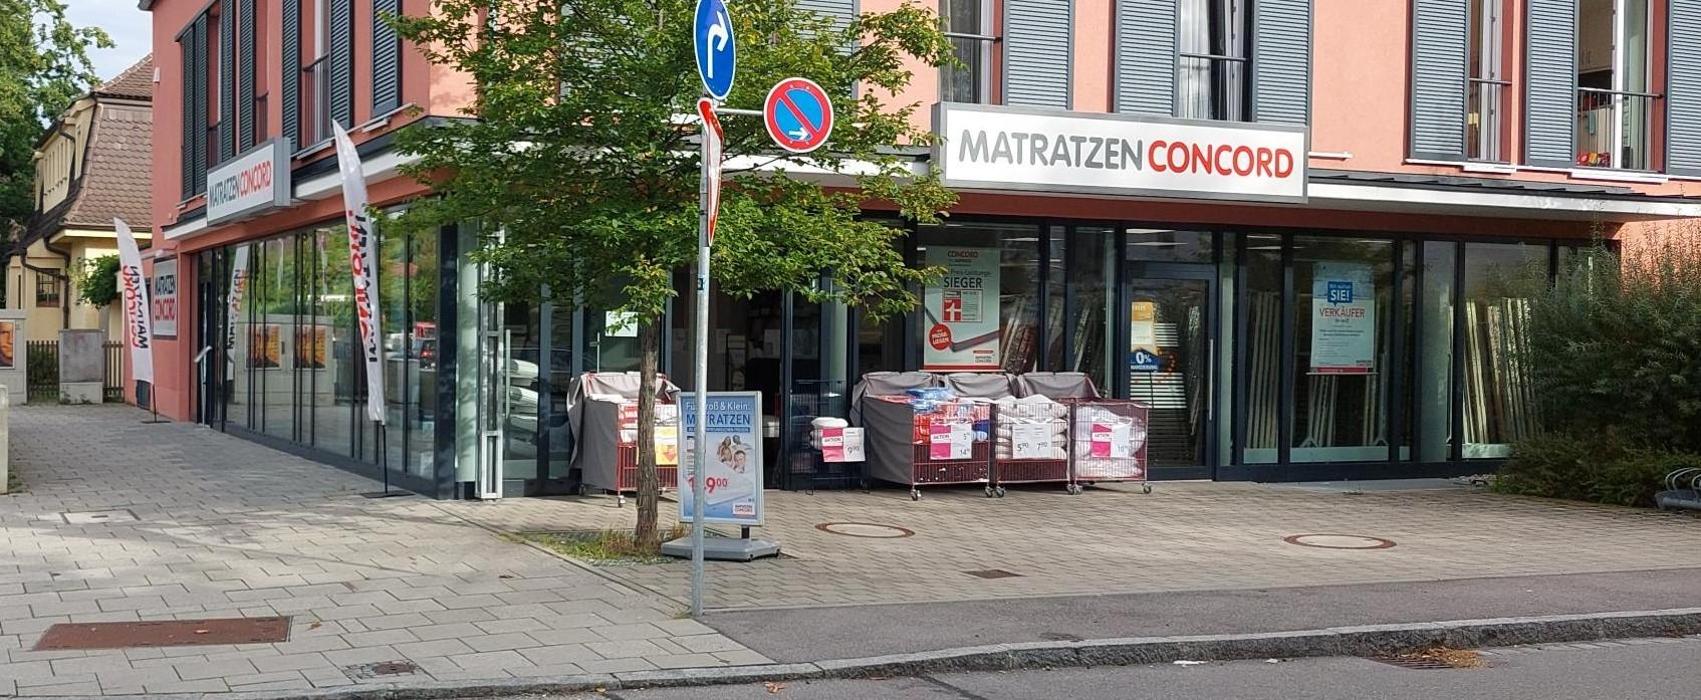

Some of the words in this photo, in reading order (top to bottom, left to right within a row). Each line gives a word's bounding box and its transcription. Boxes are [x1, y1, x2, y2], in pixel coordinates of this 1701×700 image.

[959, 129, 1143, 170] MATRATZEN
[1148, 140, 1294, 178] CONCORD
[209, 174, 240, 209] MATRATZEN
[240, 160, 272, 197] CONCORD
[155, 274, 175, 296] MATRATZEN
[943, 276, 982, 288] SIEGER
[1330, 289, 1350, 301] SIE!
[155, 298, 175, 320] CONCORD
[1319, 306, 1365, 318] VERKÄUFER
[1136, 352, 1152, 364] 0%
[720, 402, 726, 411] &
[686, 414, 750, 425] MRATZEN
[688, 475, 728, 494] 1900
